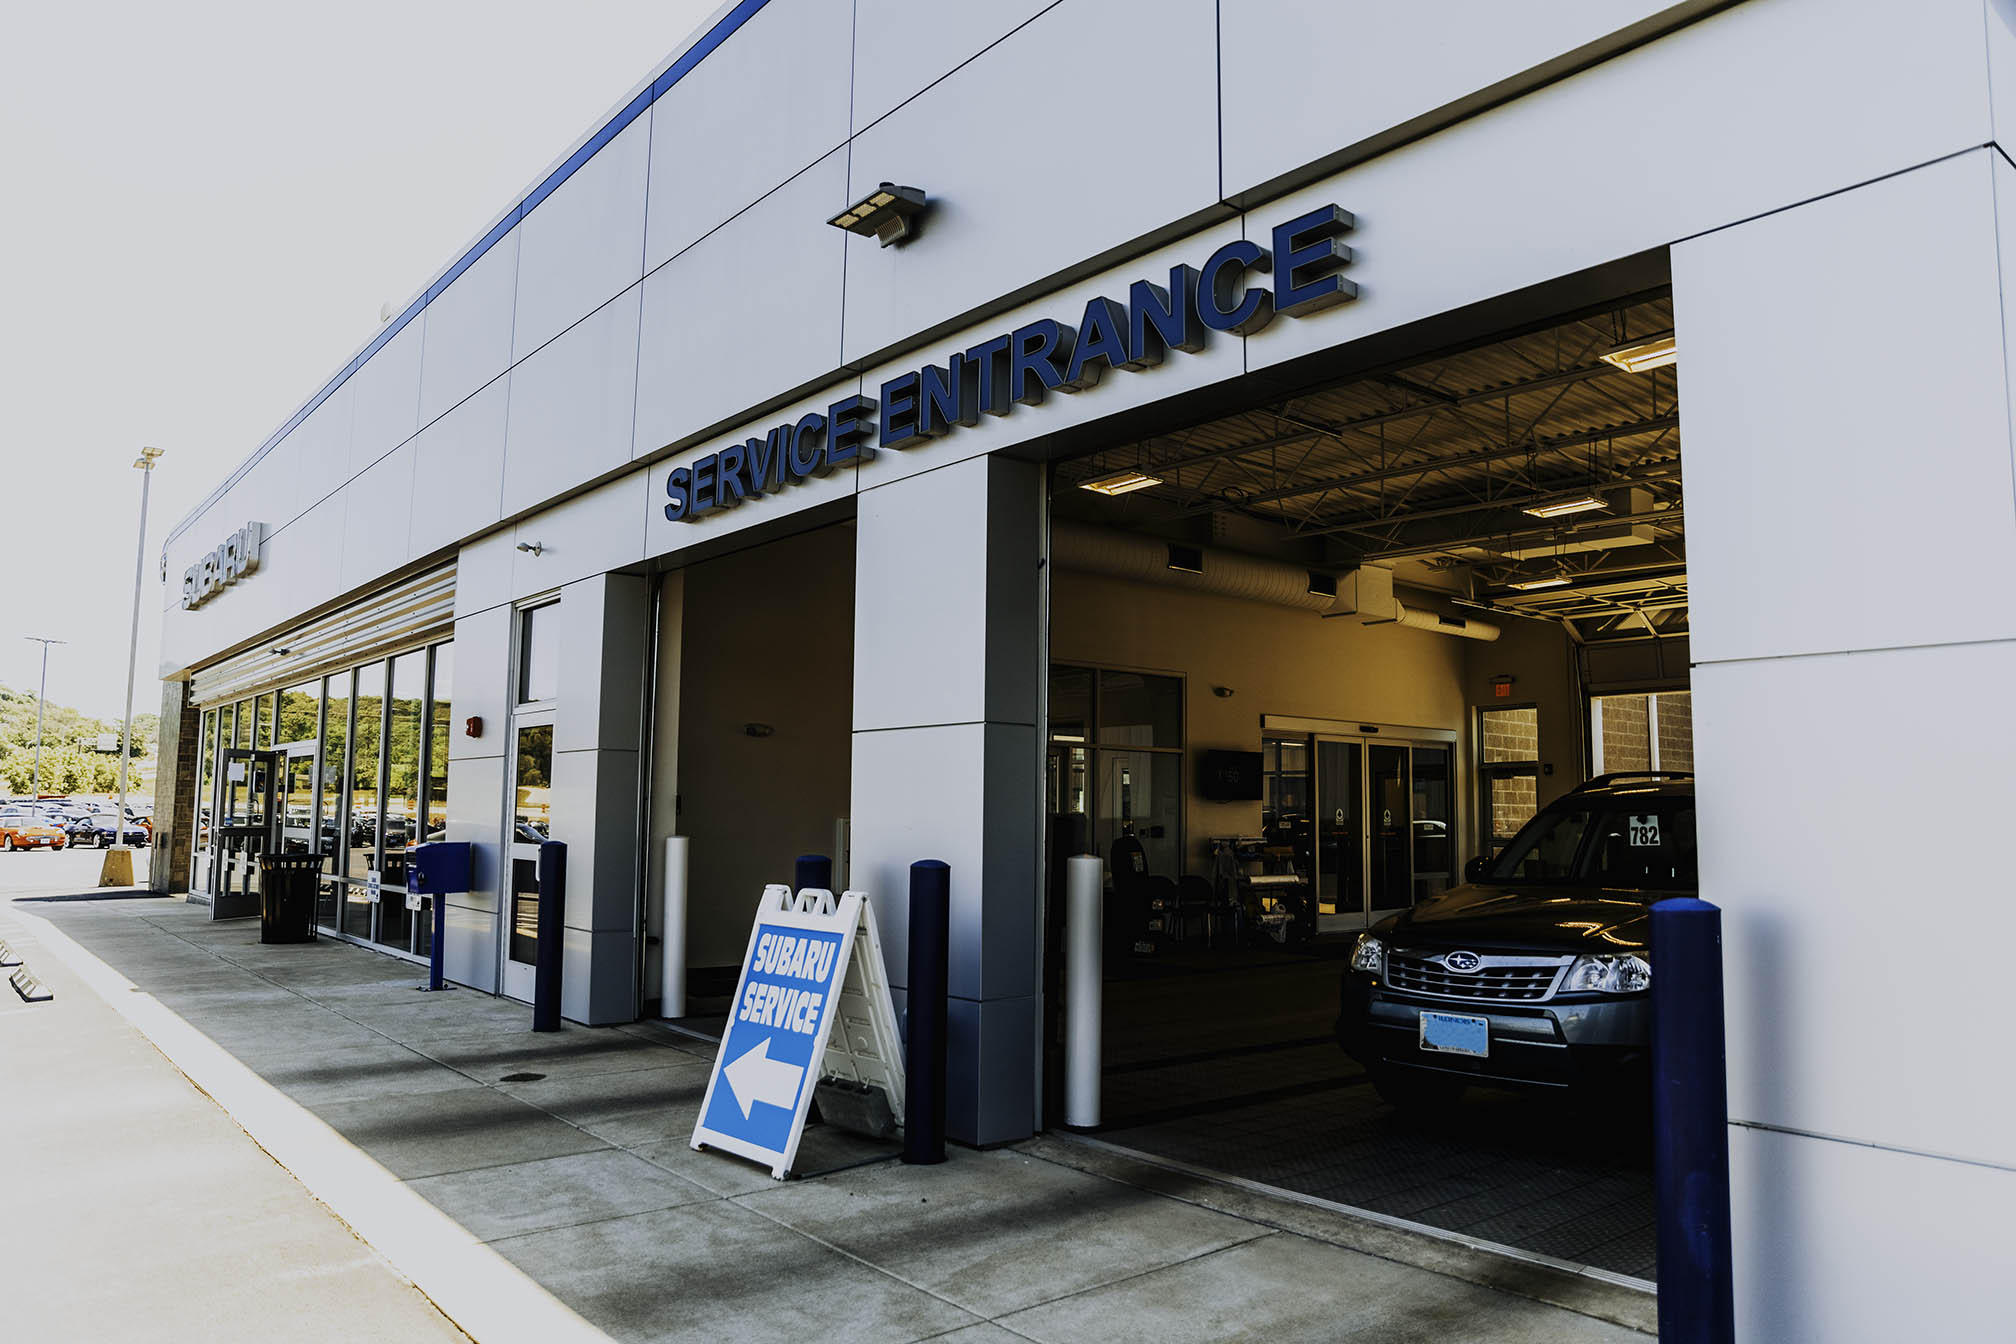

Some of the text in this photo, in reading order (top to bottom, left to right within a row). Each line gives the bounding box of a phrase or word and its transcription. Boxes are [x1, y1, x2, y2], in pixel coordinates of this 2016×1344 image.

[665, 203, 1357, 523] SERVICE ENTRANCE
[181, 521, 263, 610] SUBARU
[1630, 826, 1659, 845] 782
[753, 933, 837, 983] SUBARU
[739, 981, 824, 1035] SERVICE
